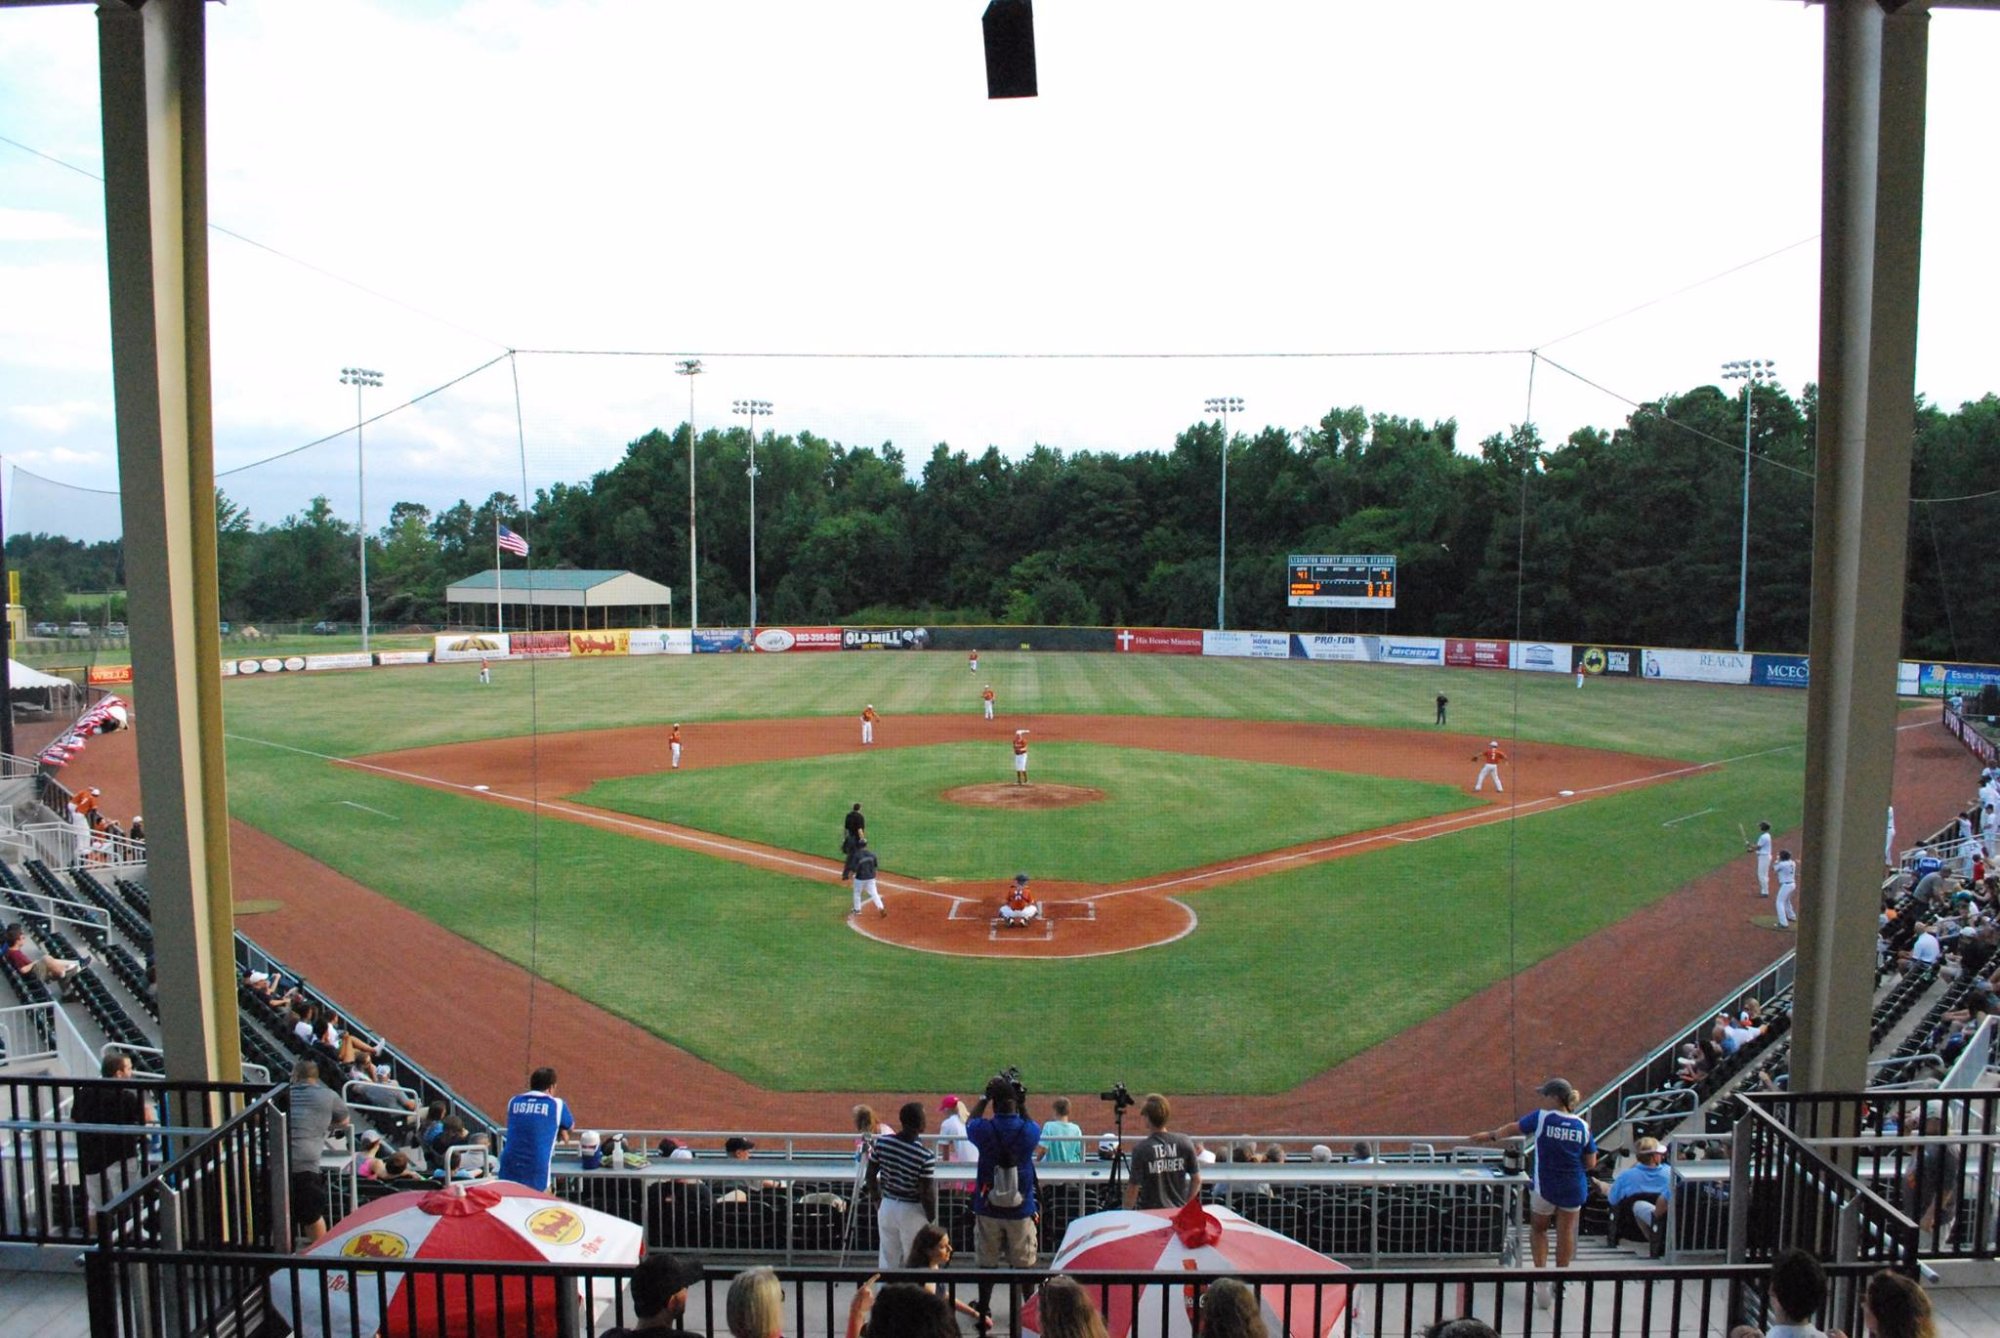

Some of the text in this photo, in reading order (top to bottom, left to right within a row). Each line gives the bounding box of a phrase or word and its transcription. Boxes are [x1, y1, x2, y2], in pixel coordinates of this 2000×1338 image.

[845, 631, 901, 645] OLD MILL
[1149, 637, 1169, 645] House
[1171, 638, 1202, 646] Ministries
[1391, 648, 1438, 657] MICHELIN
[512, 1102, 549, 1116] USHER
[1546, 1125, 1583, 1144] USHER
[1148, 1158, 1185, 1174] MEMBER
